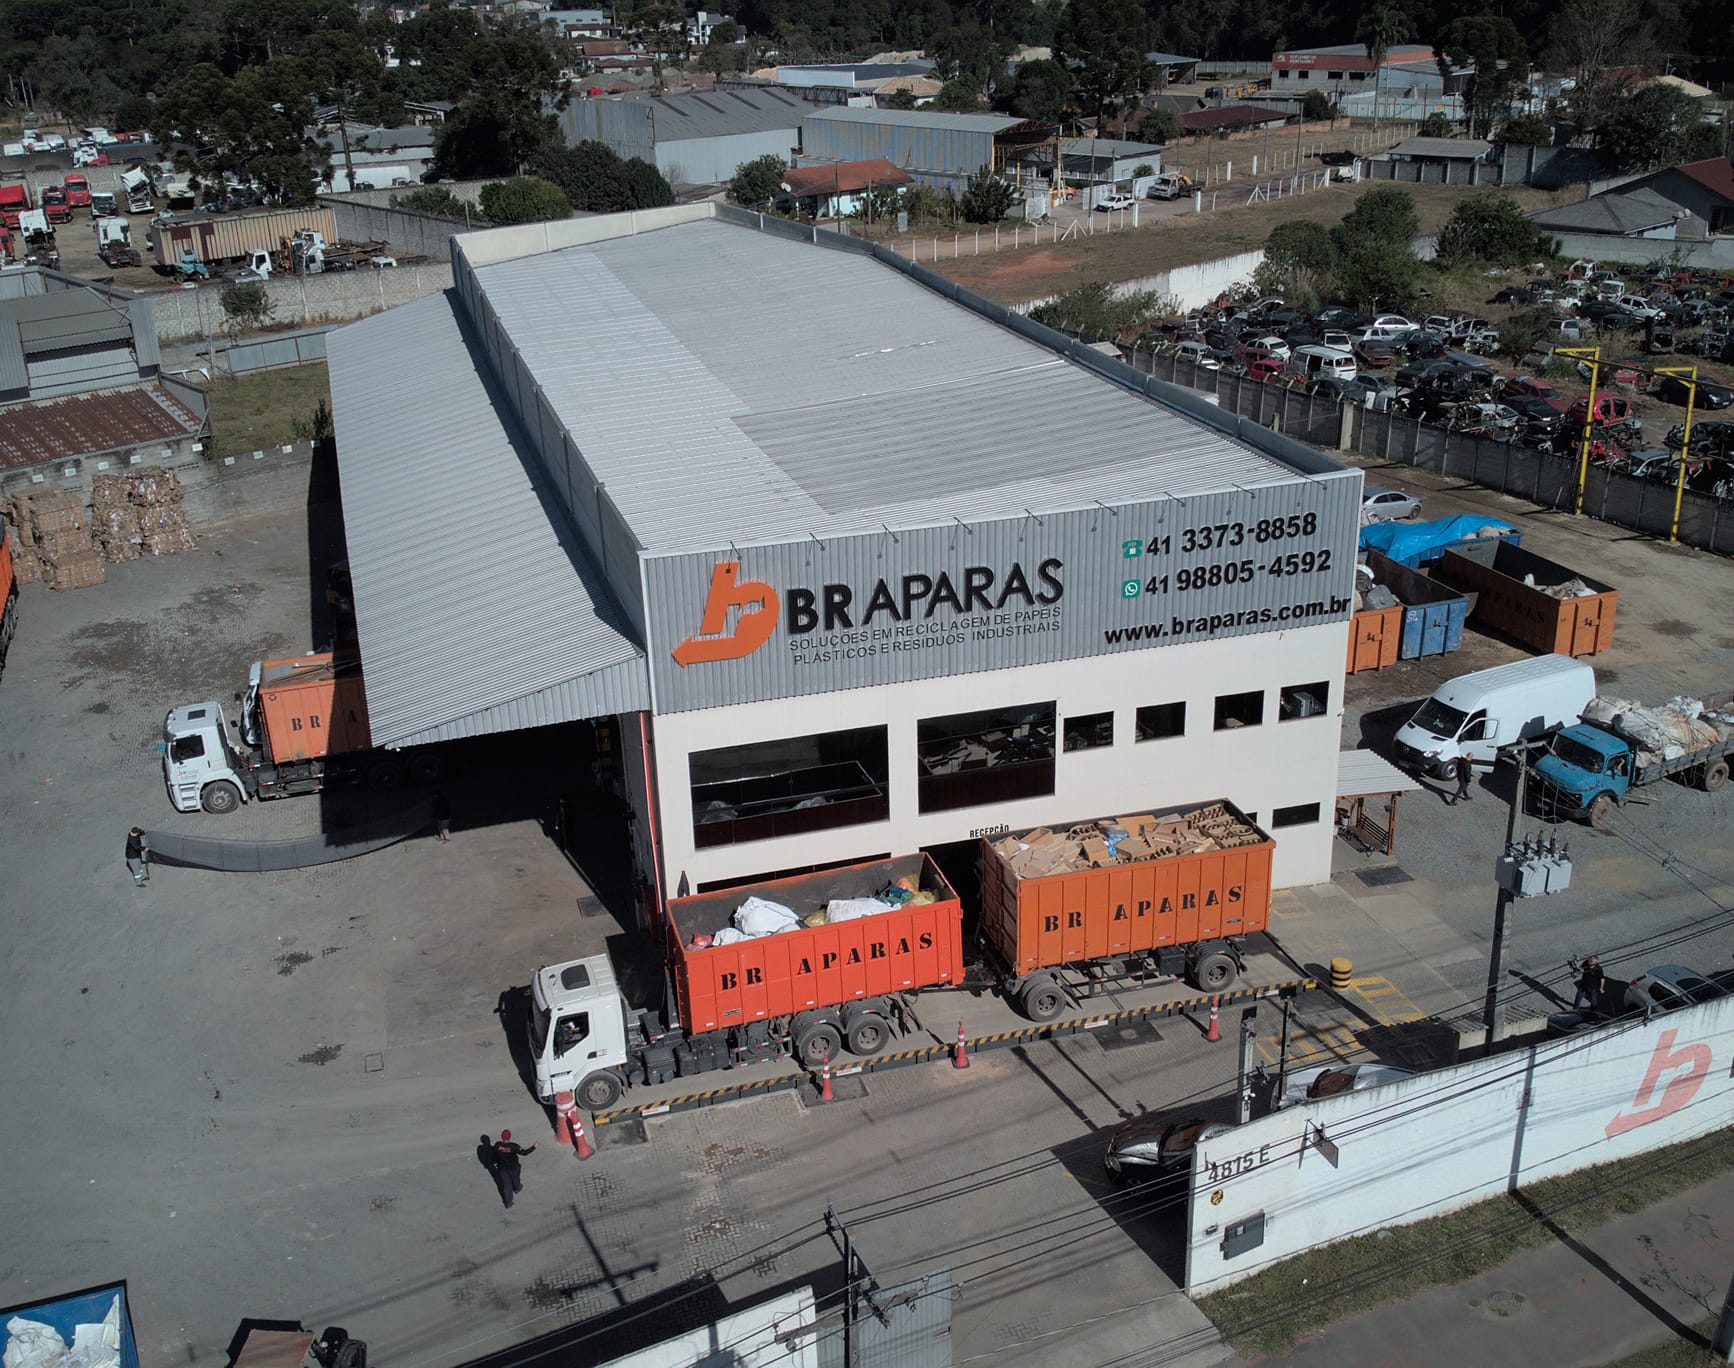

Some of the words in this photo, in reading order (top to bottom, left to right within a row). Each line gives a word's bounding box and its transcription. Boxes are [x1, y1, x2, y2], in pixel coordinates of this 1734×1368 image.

[1147, 535, 1170, 556] 41
[1181, 512, 1317, 552] 3373-8858
[1145, 575, 1169, 595] 41
[1176, 549, 1331, 591] 98805-4592
[790, 630, 869, 651] SOLUÇÕES
[873, 628, 892, 641] EM
[896, 616, 990, 637] RECICLAGEM
[994, 614, 1010, 625] DE
[1104, 595, 1351, 644] www.braparas.com.br
[794, 644, 877, 665] PLÁSTICOS
[881, 643, 889, 653] E
[972, 620, 1060, 641] INDUSTRIAIS
[291, 715, 321, 731] BR
[1044, 911, 1082, 932] BR
[1113, 885, 1242, 921] APARAS
[720, 967, 763, 991] BR
[797, 932, 933, 976] APARAS
